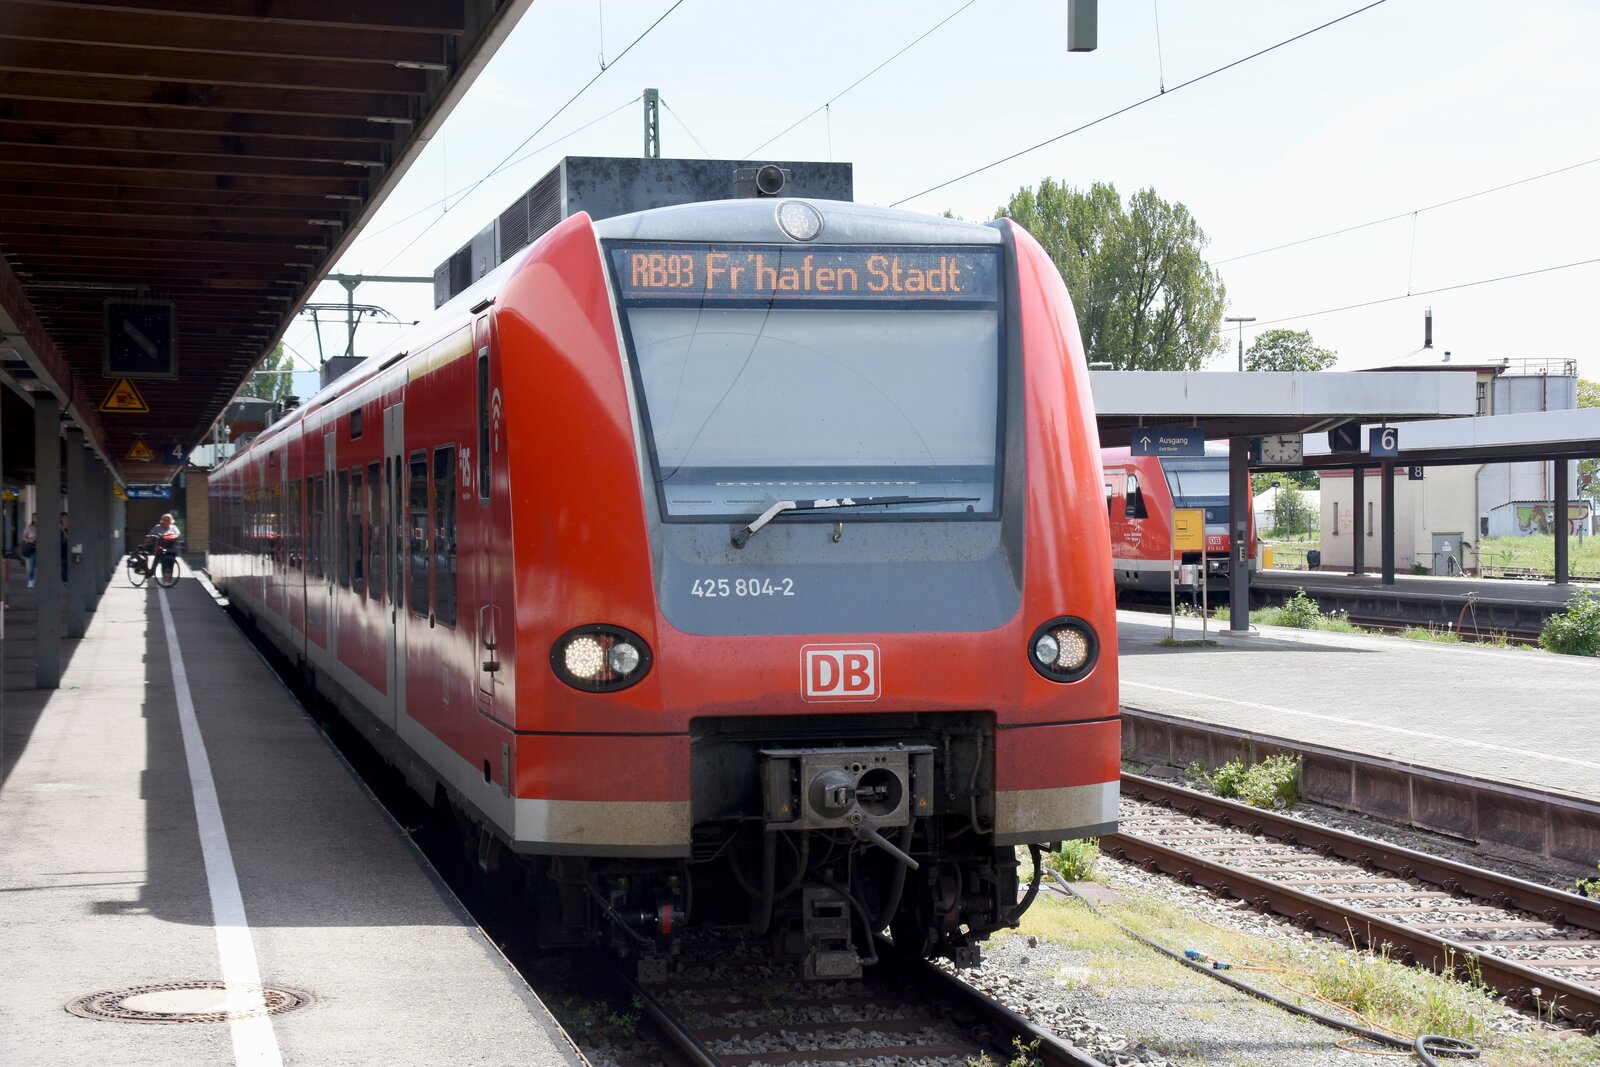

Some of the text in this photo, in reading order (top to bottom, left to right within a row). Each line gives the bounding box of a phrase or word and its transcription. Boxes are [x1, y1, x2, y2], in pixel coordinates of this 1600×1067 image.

[632, 253, 961, 293] RB93 Fr'hafen Stadt
[1159, 436, 1188, 446] Ausgang
[1381, 429, 1395, 451] 6
[172, 444, 183, 459] 4
[1414, 466, 1422, 478] 8
[691, 577, 795, 597] 425 804-2
[811, 653, 871, 692] DB
